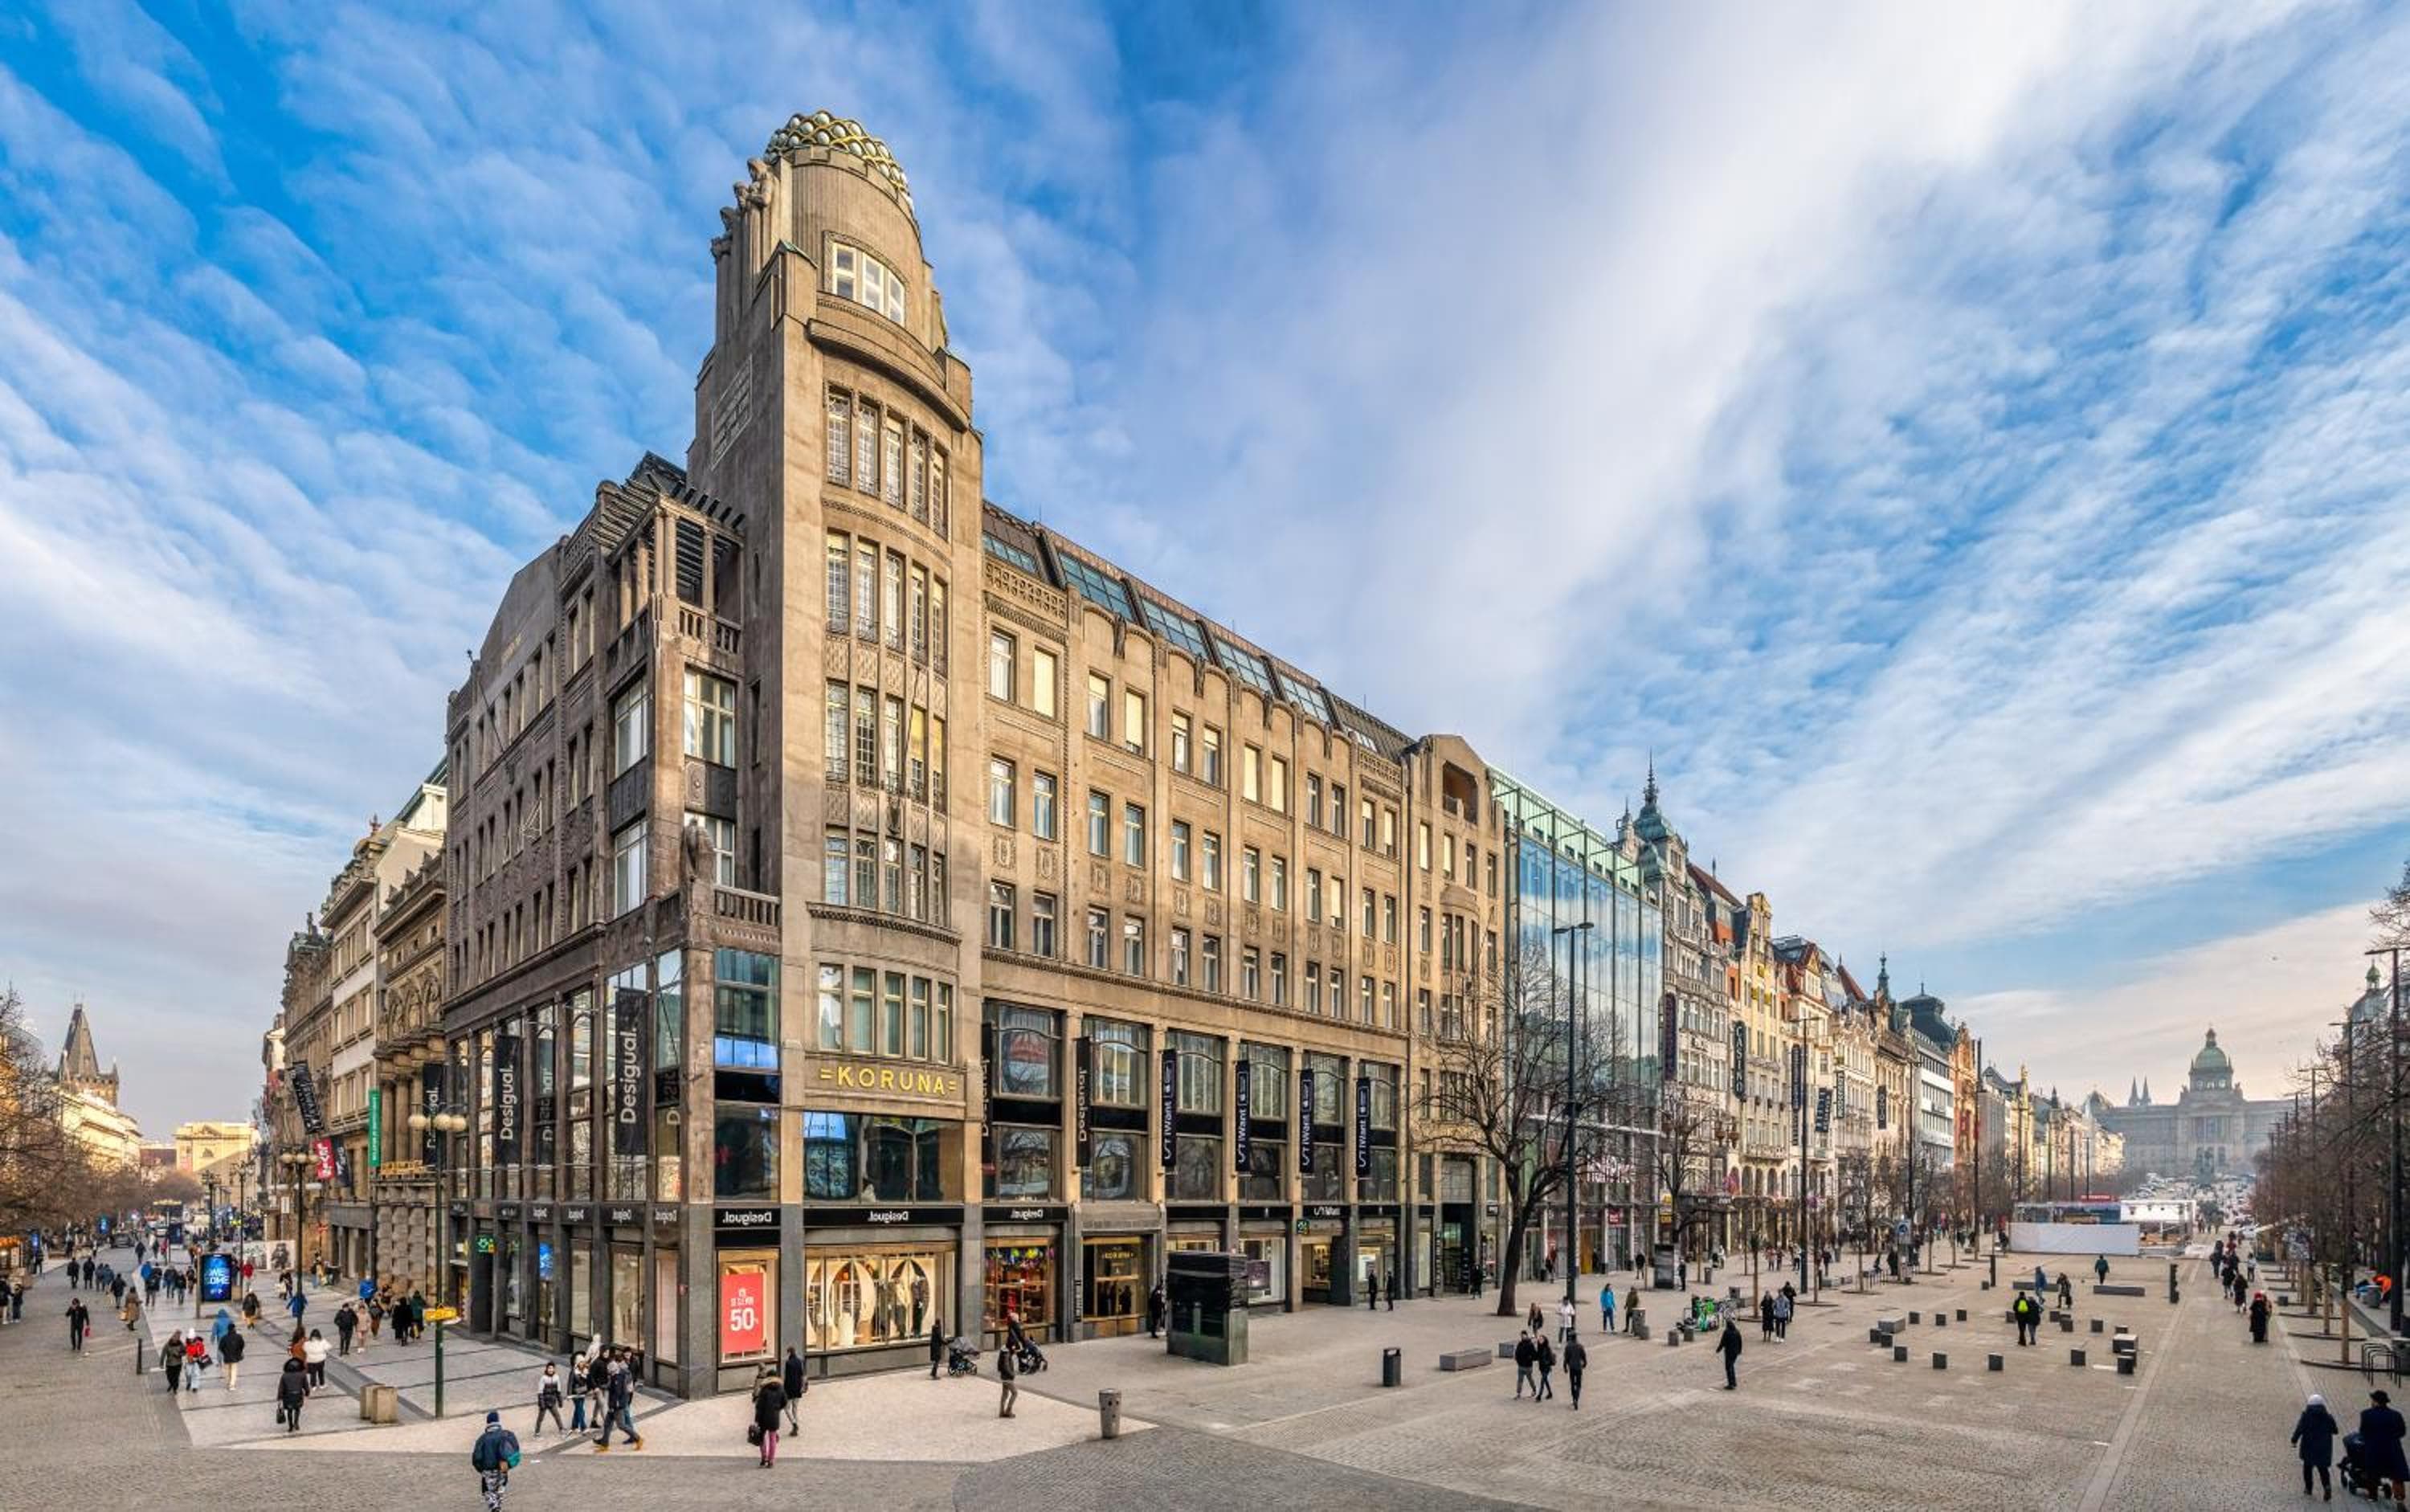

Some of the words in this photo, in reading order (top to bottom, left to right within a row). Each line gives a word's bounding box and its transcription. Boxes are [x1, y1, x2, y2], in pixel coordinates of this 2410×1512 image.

[619, 1028, 641, 1124] Desigual.
[837, 1066, 946, 1094] KORUNA
[1735, 1026, 1743, 1092] CASINO
[499, 1065, 517, 1140] Desigual.
